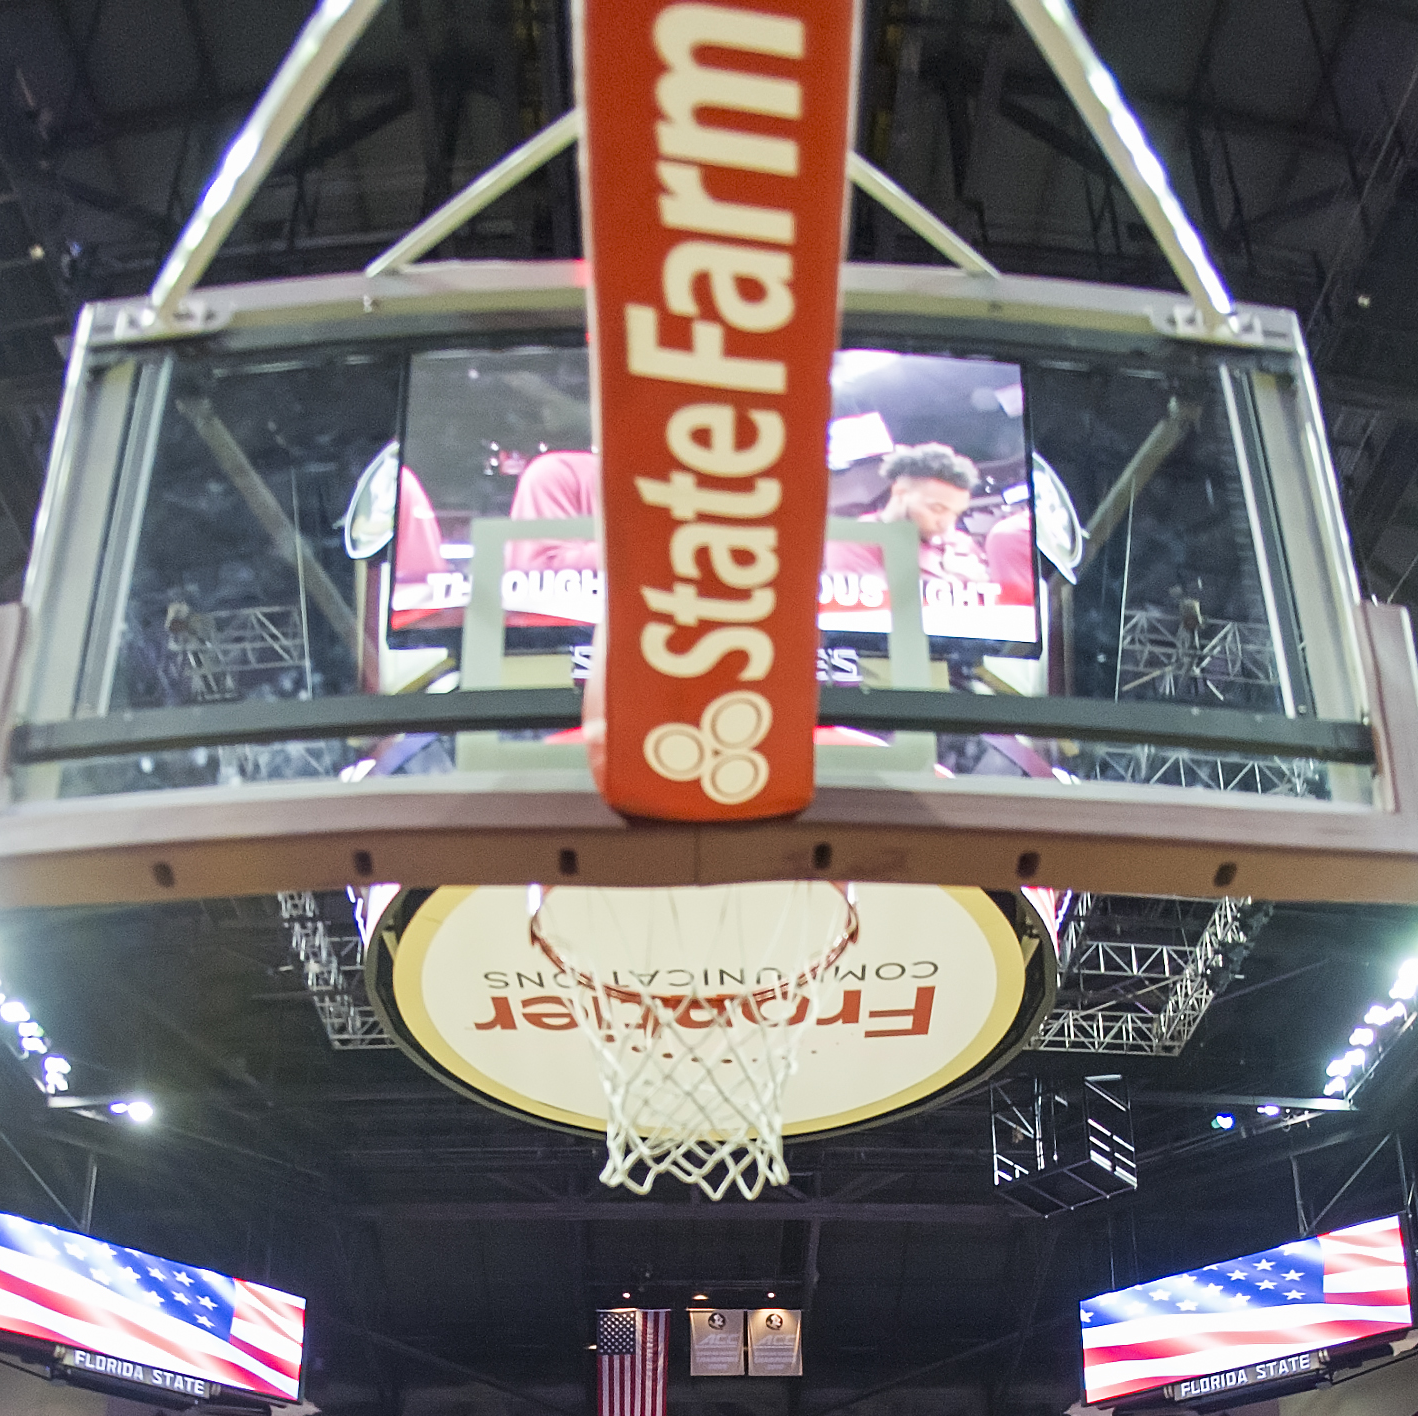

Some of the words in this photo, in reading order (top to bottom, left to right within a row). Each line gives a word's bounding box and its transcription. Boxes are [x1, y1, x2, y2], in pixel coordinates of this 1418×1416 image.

[483, 960, 939, 990] COMUNICATONS
[699, 1333, 739, 1345] ACC
[74, 1349, 144, 1381] FLORIDA
[151, 1369, 205, 1395] STATE
[1181, 1369, 1249, 1398] FLORIDA
[1256, 1353, 1310, 1380] STATE
